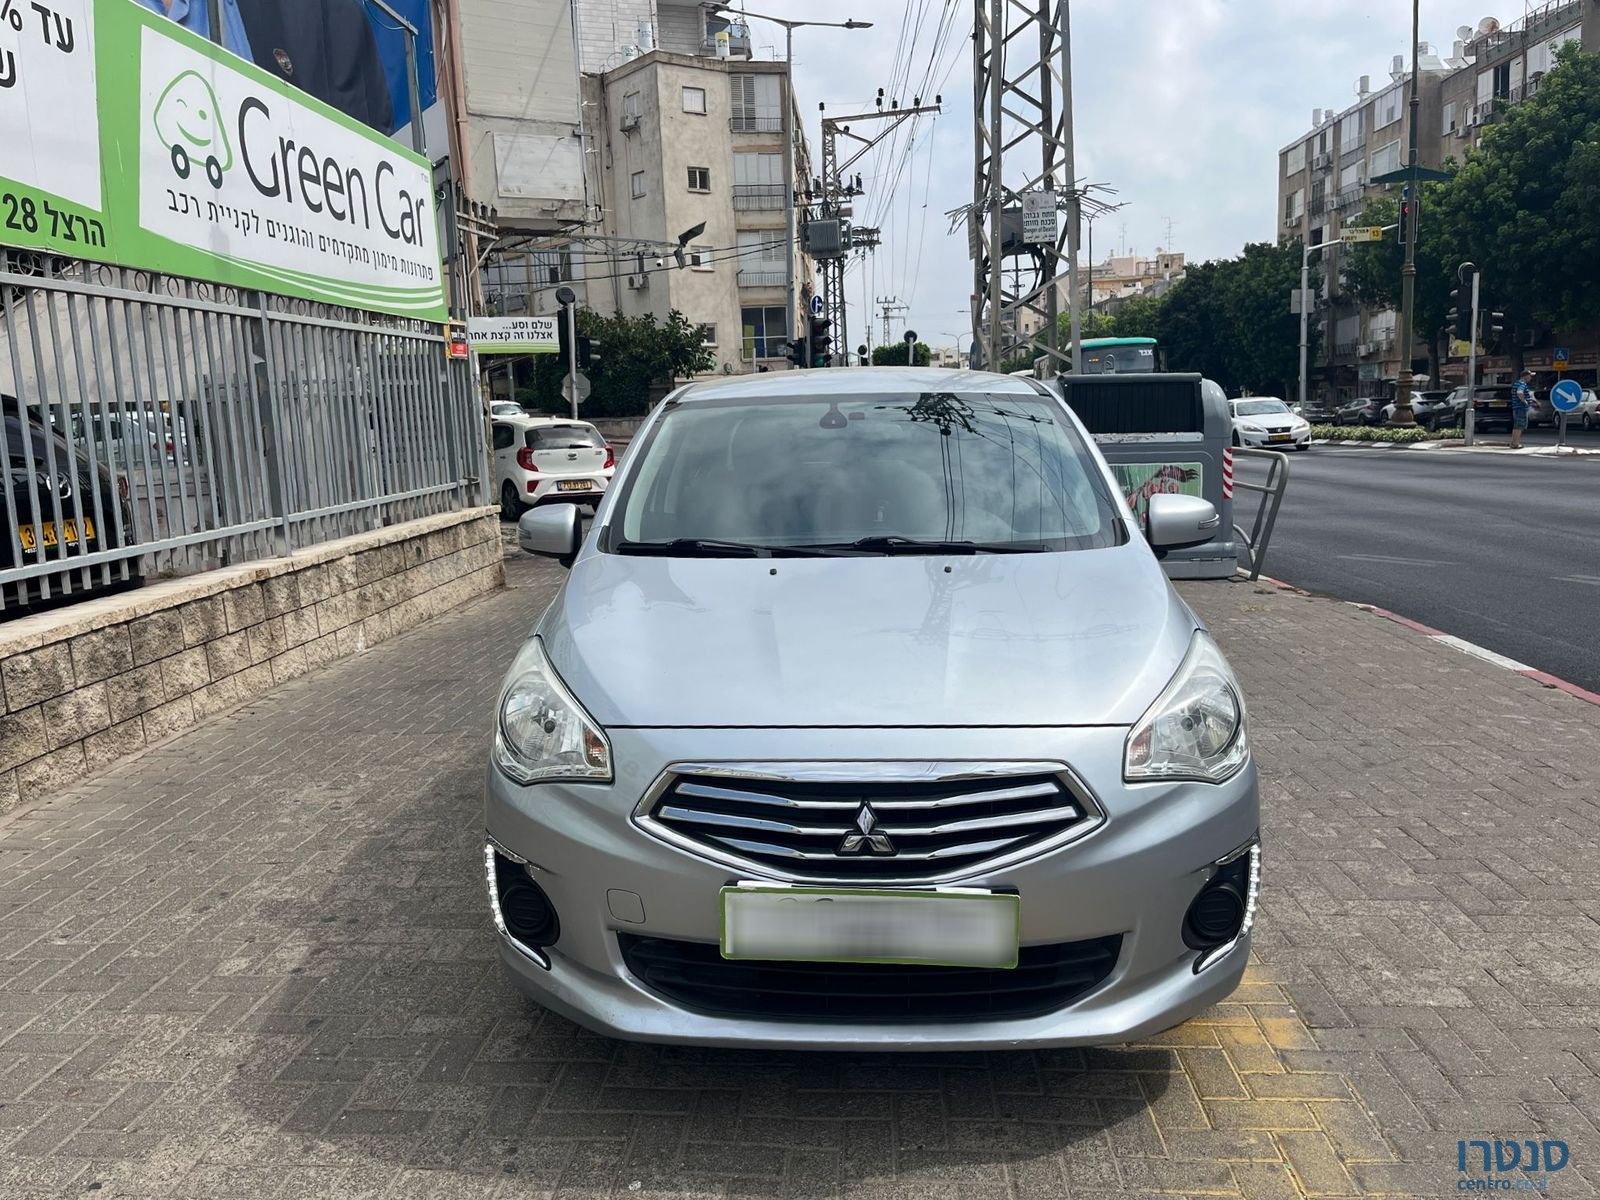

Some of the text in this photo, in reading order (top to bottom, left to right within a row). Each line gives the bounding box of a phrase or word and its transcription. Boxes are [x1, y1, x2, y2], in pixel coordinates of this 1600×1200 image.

[31, 1, 74, 53] עד
[238, 96, 425, 248] Green Car
[2, 192, 106, 248] הרצל 28
[167, 189, 434, 281] פתרונות מימון מתקדמים והוגנים לקניית רכב
[490, 331, 511, 341] קצת
[513, 331, 524, 340] זה
[527, 330, 553, 340] אצלנו
[531, 319, 553, 329] שלם
